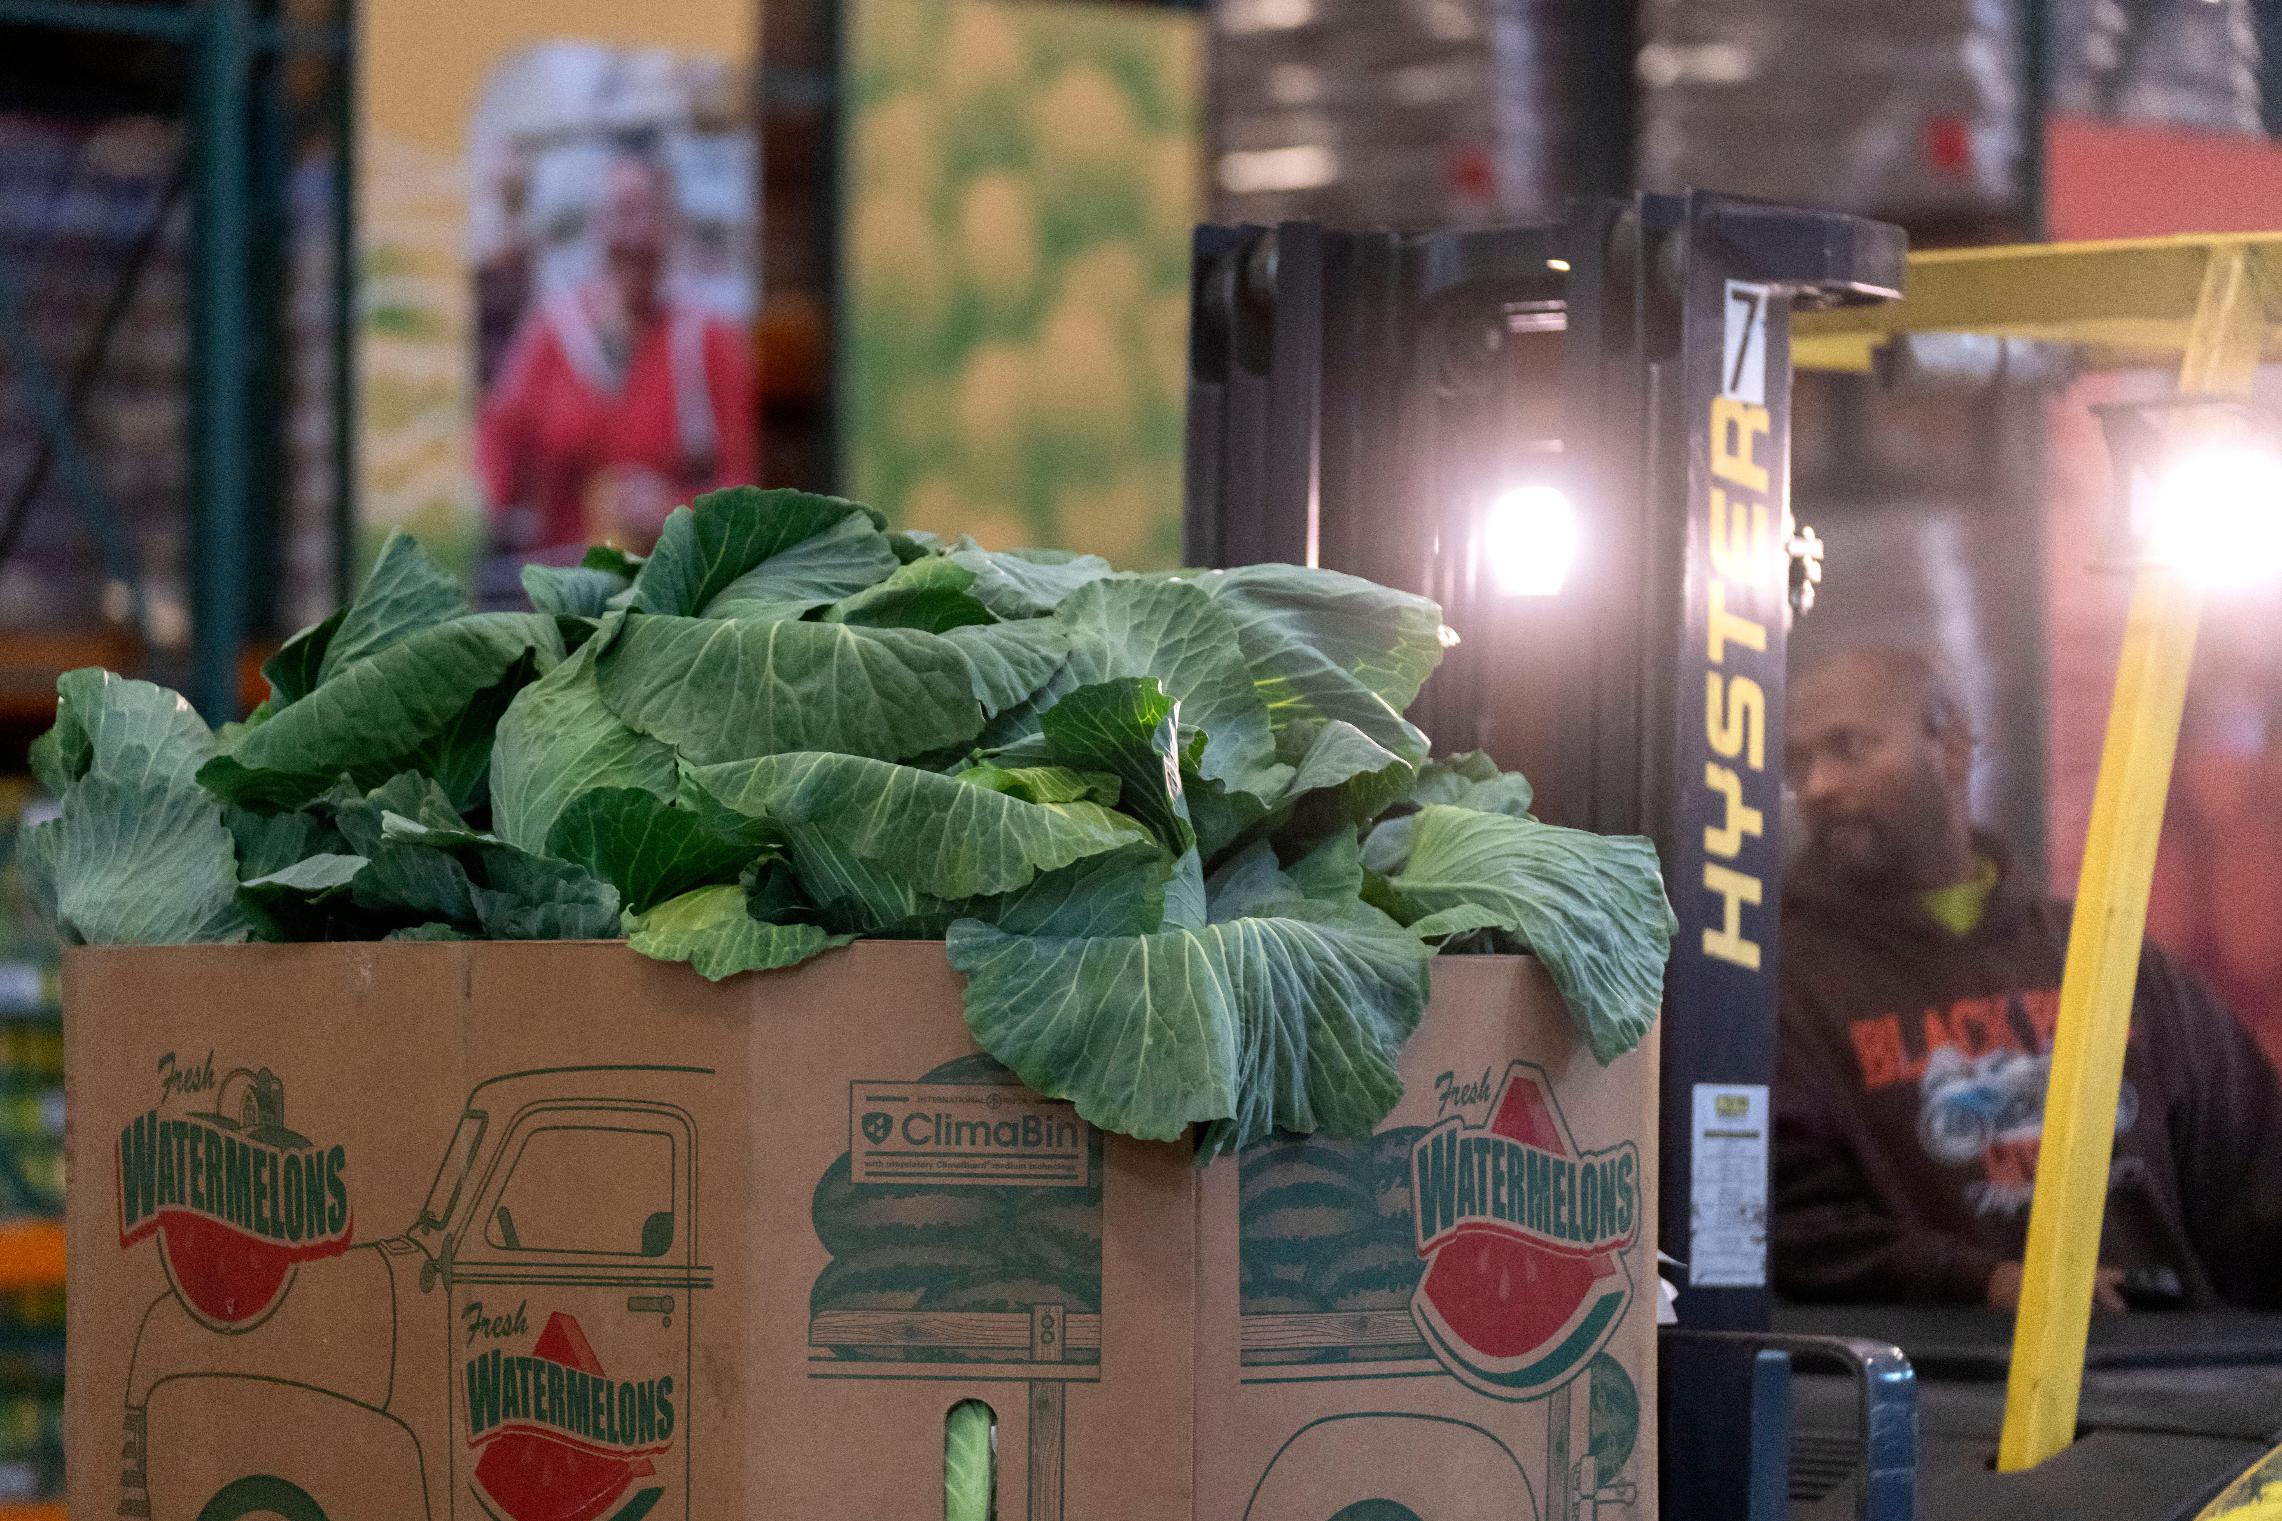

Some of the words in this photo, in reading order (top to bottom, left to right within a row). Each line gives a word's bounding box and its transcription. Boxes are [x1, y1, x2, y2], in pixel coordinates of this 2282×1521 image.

[1731, 290, 1760, 392] 7
[1701, 394, 1770, 970] HYSTER
[158, 1050, 216, 1104] Fresh
[1435, 1066, 1491, 1118] Fresh
[121, 1110, 347, 1241] WATERMELONS
[902, 1112, 1078, 1147] ClimaBin
[1417, 1127, 1633, 1243] WATERMELONS
[461, 1300, 529, 1348] Fresh
[467, 1349, 674, 1446] WATERMELONS
